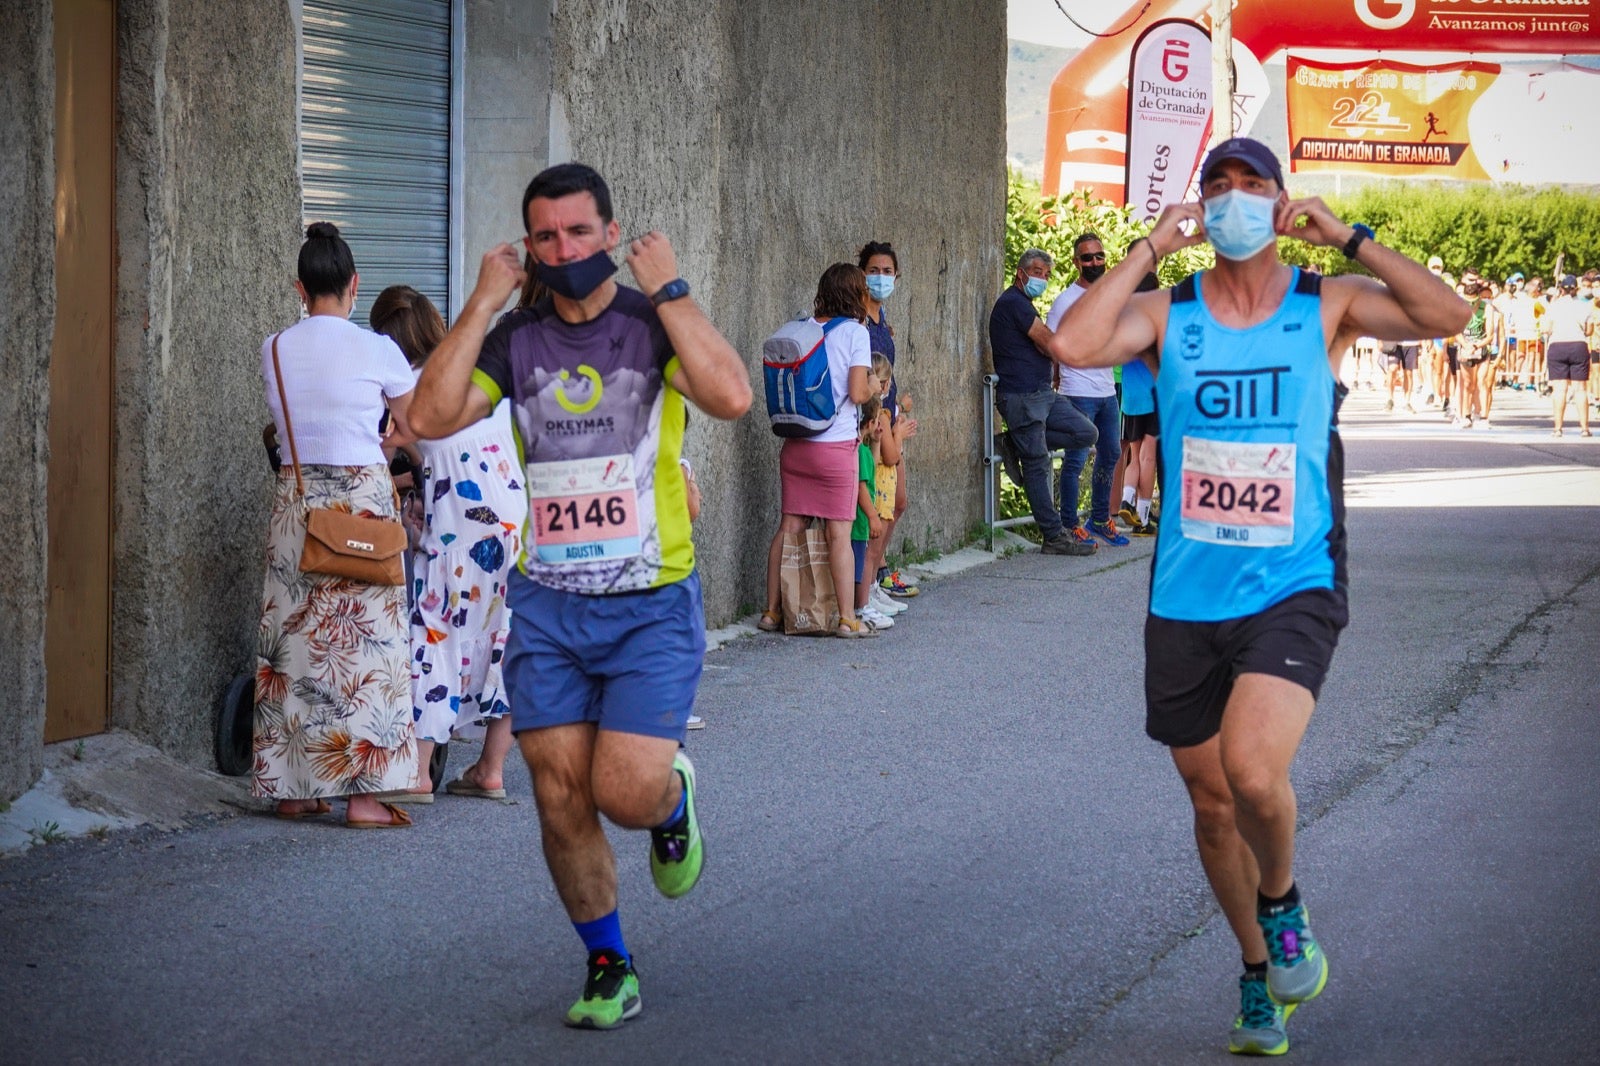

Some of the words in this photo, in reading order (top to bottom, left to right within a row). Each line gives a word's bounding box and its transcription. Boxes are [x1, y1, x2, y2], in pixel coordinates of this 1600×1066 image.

[1428, 15, 1526, 31] Avanzamos
[1530, 17, 1590, 34] junt@s
[1139, 80, 1208, 100] Diputación
[1138, 96, 1154, 109] de
[1155, 98, 1206, 115] Granada
[1138, 113, 1179, 124] Avanzamos
[1302, 141, 1373, 161] DIPUTACIÓN
[1375, 145, 1391, 162] DE
[1393, 145, 1451, 163] GRANADA
[545, 416, 614, 431] OKEYMAS
[1198, 479, 1281, 513] 2042
[546, 496, 626, 532] 2146
[1216, 526, 1249, 541] EMILIO
